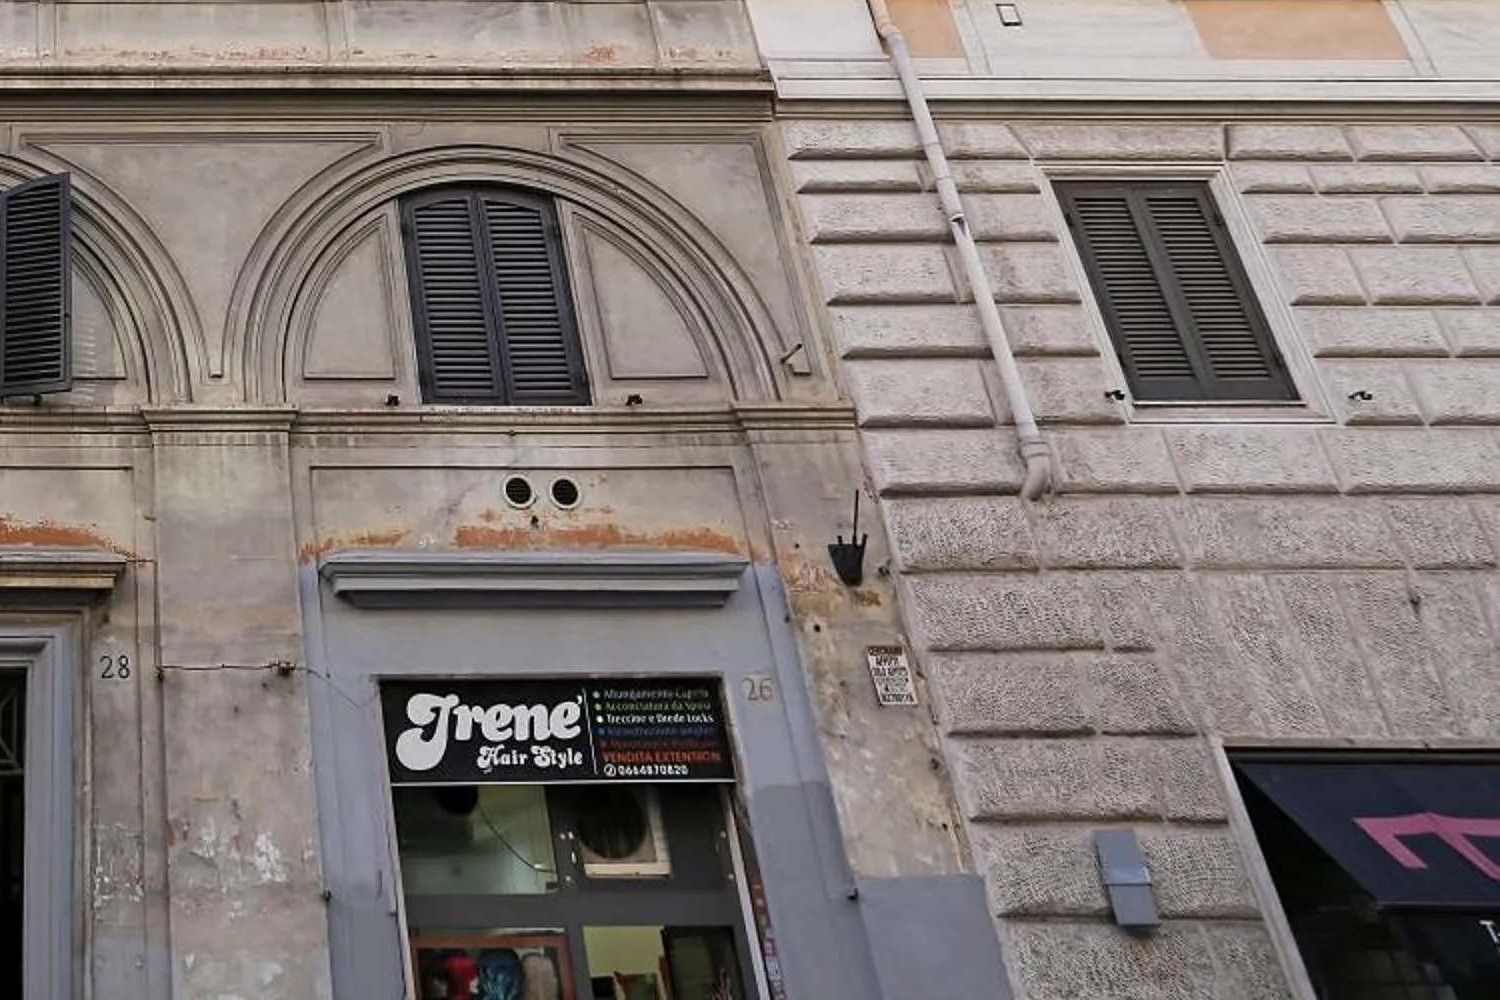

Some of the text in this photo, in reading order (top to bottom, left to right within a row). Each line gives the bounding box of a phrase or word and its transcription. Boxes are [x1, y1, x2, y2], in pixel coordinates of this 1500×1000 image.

[99, 655, 131, 679] 28
[741, 677, 773, 701] 26
[477, 745, 583, 771] Hair Style
